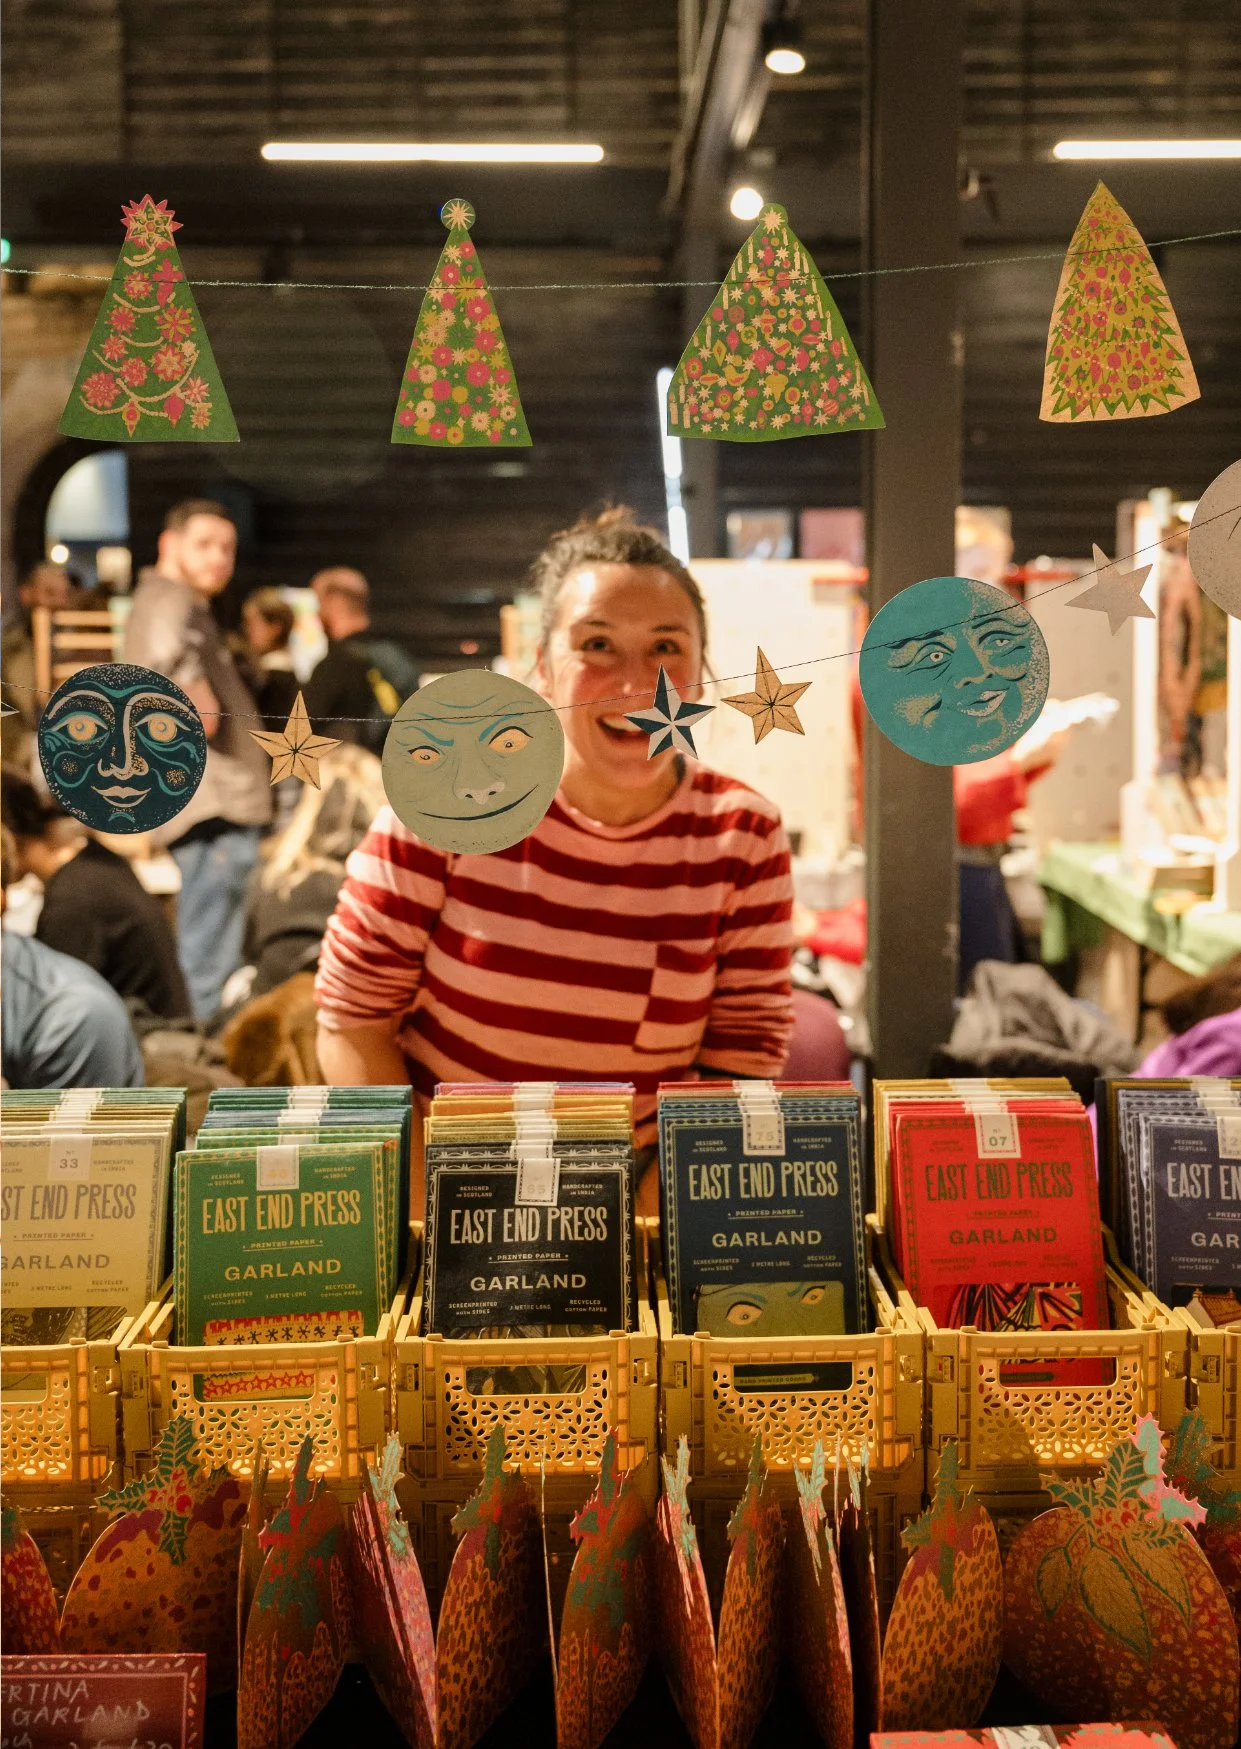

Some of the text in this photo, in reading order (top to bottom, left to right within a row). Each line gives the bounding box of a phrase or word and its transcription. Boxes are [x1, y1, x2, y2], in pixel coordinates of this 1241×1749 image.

[989, 1136, 1008, 1147] 07
[59, 1159, 78, 1169] 33
[688, 1160, 839, 1200] EAST END PRESS
[925, 1161, 1073, 1201] EAST END PRESS
[1166, 1162, 1212, 1199] EAST
[31, 1184, 68, 1220] END
[74, 1183, 137, 1220] PRESS
[202, 1190, 361, 1234] EAST END PRESS
[735, 1208, 797, 1217] PRINTED PAPER
[450, 1206, 608, 1244] EAST END PRESS
[250, 1240, 287, 1249] PRINTED
[711, 1230, 823, 1248] GARLAND
[949, 1227, 1058, 1245] GARLAND
[1191, 1231, 1239, 1248] GAR
[224, 1259, 342, 1281] GARLAND
[470, 1274, 587, 1291] GARLAND
[12, 1700, 150, 1726] GARLAND
